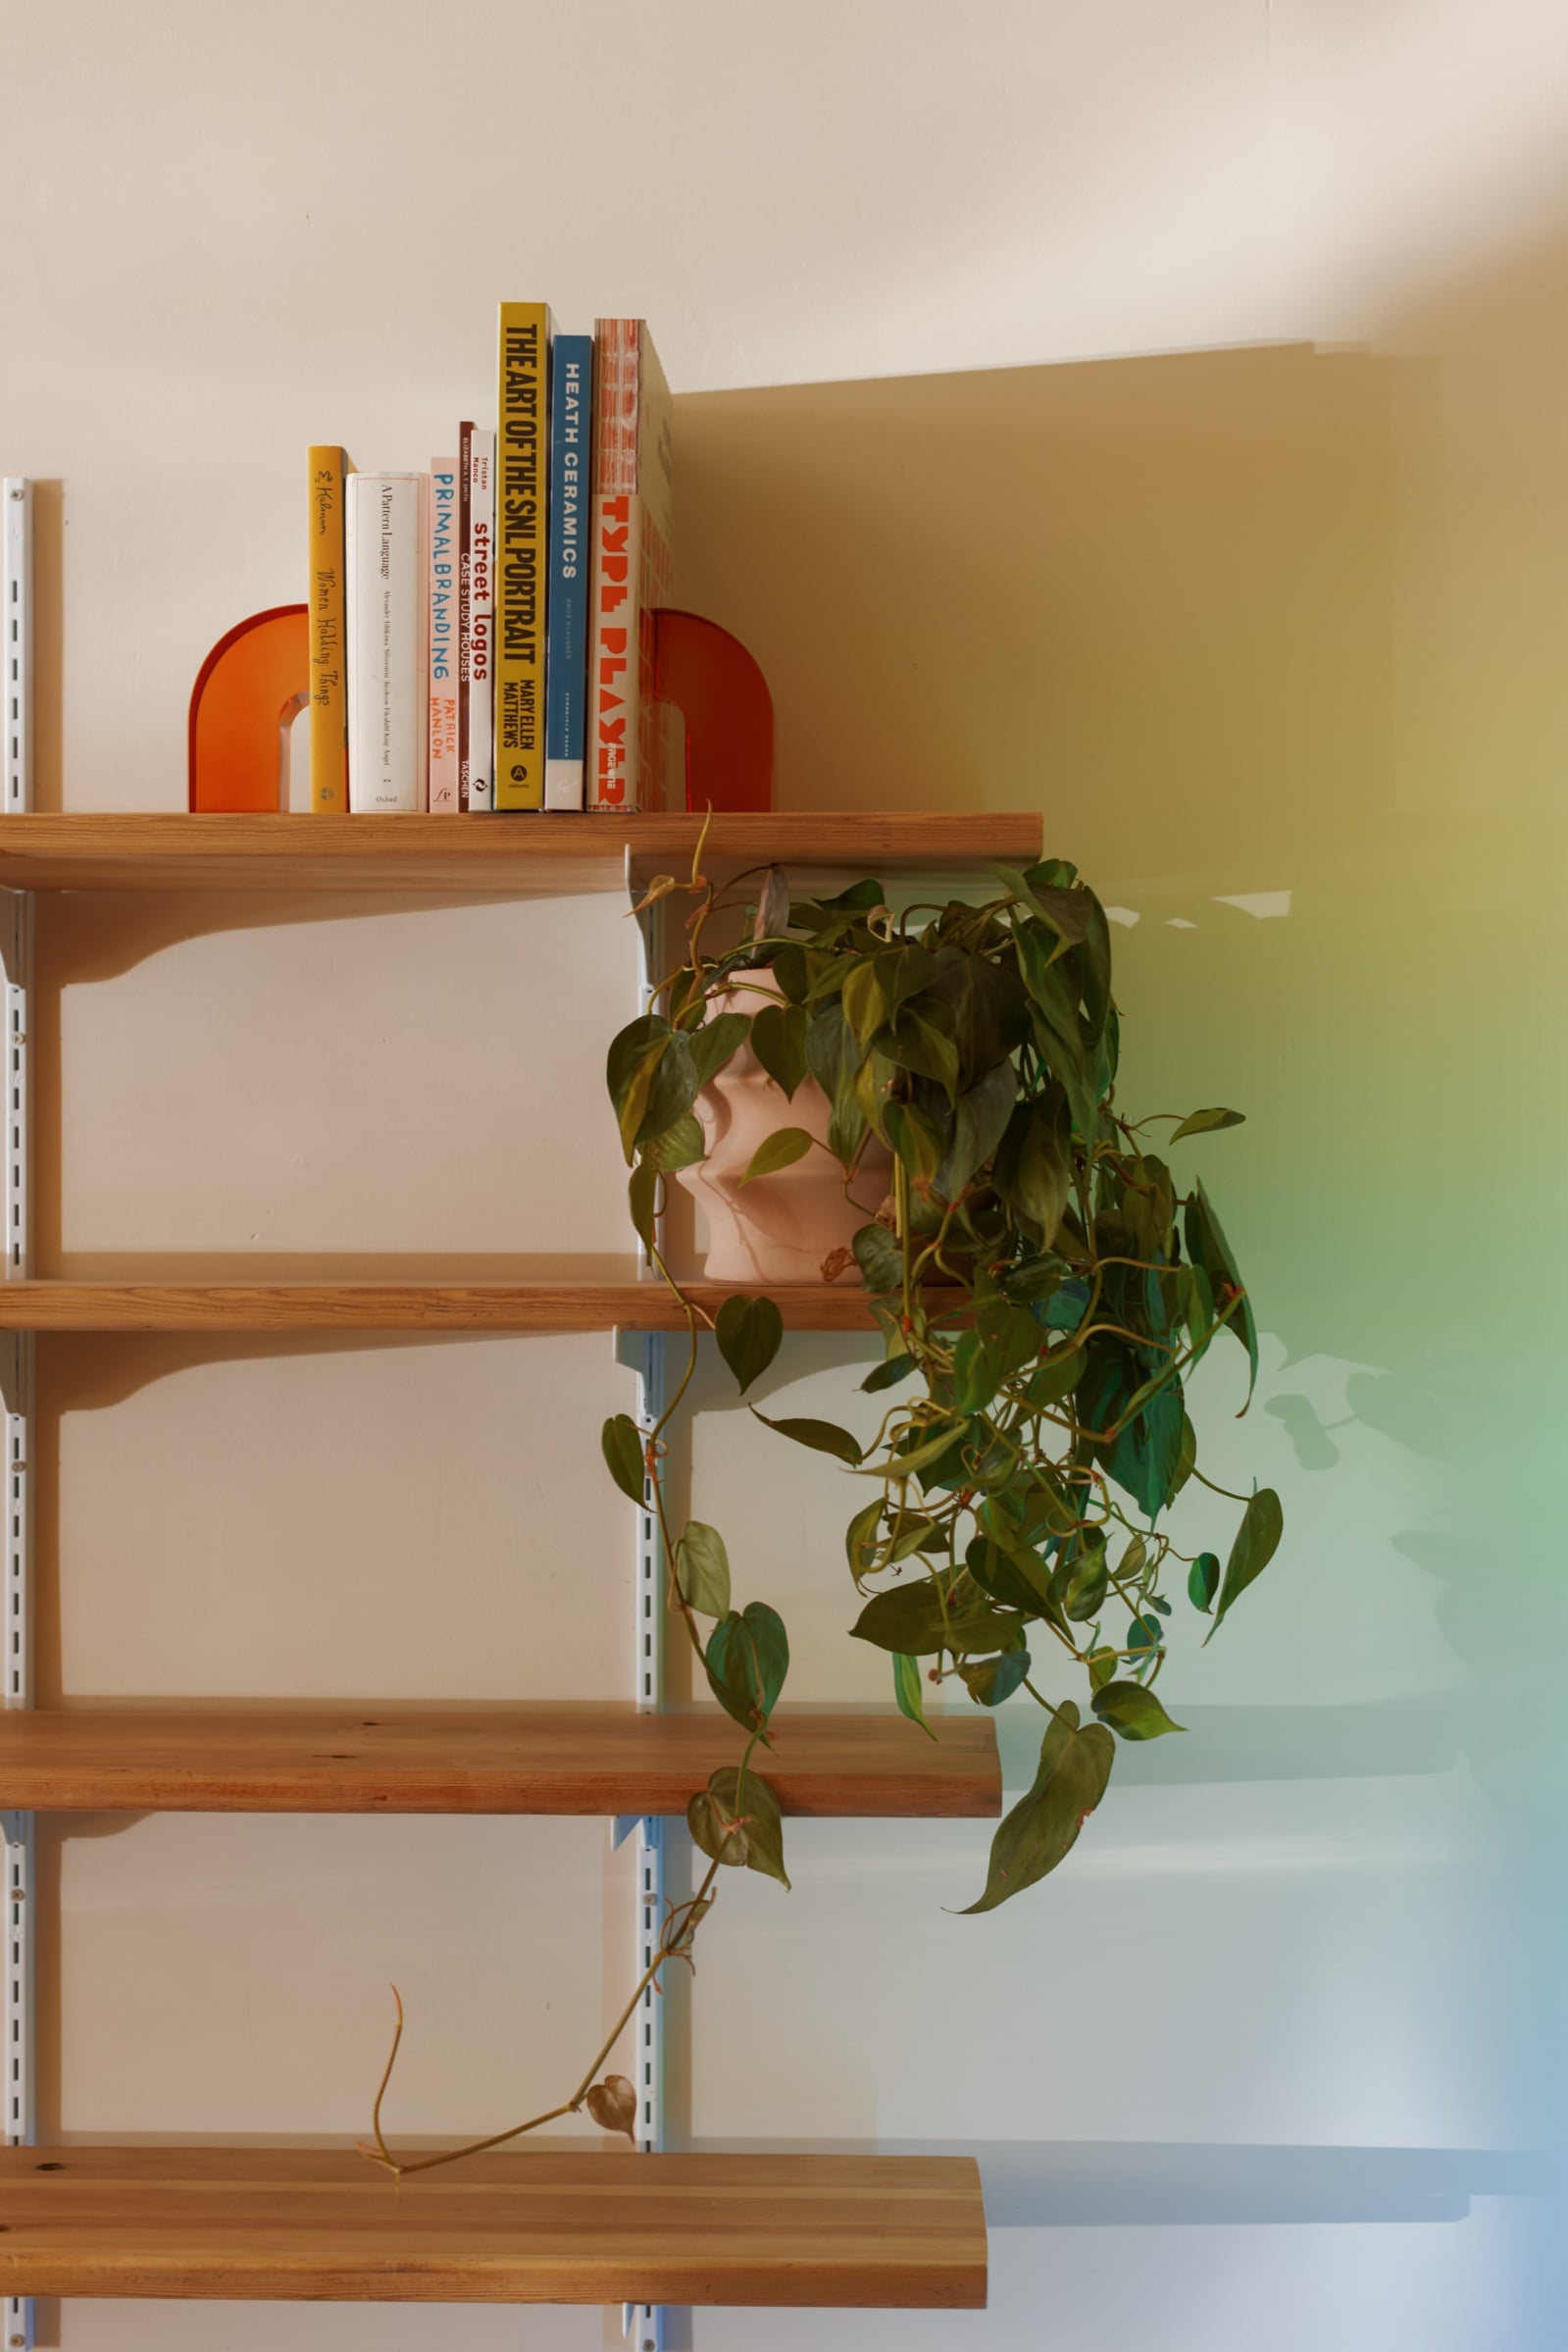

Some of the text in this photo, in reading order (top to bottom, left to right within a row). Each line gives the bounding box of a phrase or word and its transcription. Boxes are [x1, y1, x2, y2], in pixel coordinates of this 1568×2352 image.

[504, 324, 537, 664] THE ART OF THE SNL PORTRAIT
[562, 363, 581, 579] HEATH CERAMICS
[315, 486, 333, 535] Kalman
[381, 494, 392, 530] Pattern
[379, 532, 392, 580] Language
[431, 474, 455, 680] PRIMALBRANDING
[313, 567, 338, 706] Women Holding Things
[461, 553, 471, 682] CASE STUDY HOUSES
[471, 523, 491, 681] street logos
[598, 495, 630, 805] TYPE PLAYER
[430, 697, 443, 759] HANLON
[444, 698, 456, 753] PATRICK
[503, 682, 519, 748] MATTHEWS
[520, 680, 534, 750] MARY ELLEN
[461, 760, 470, 798] TASCHEN
